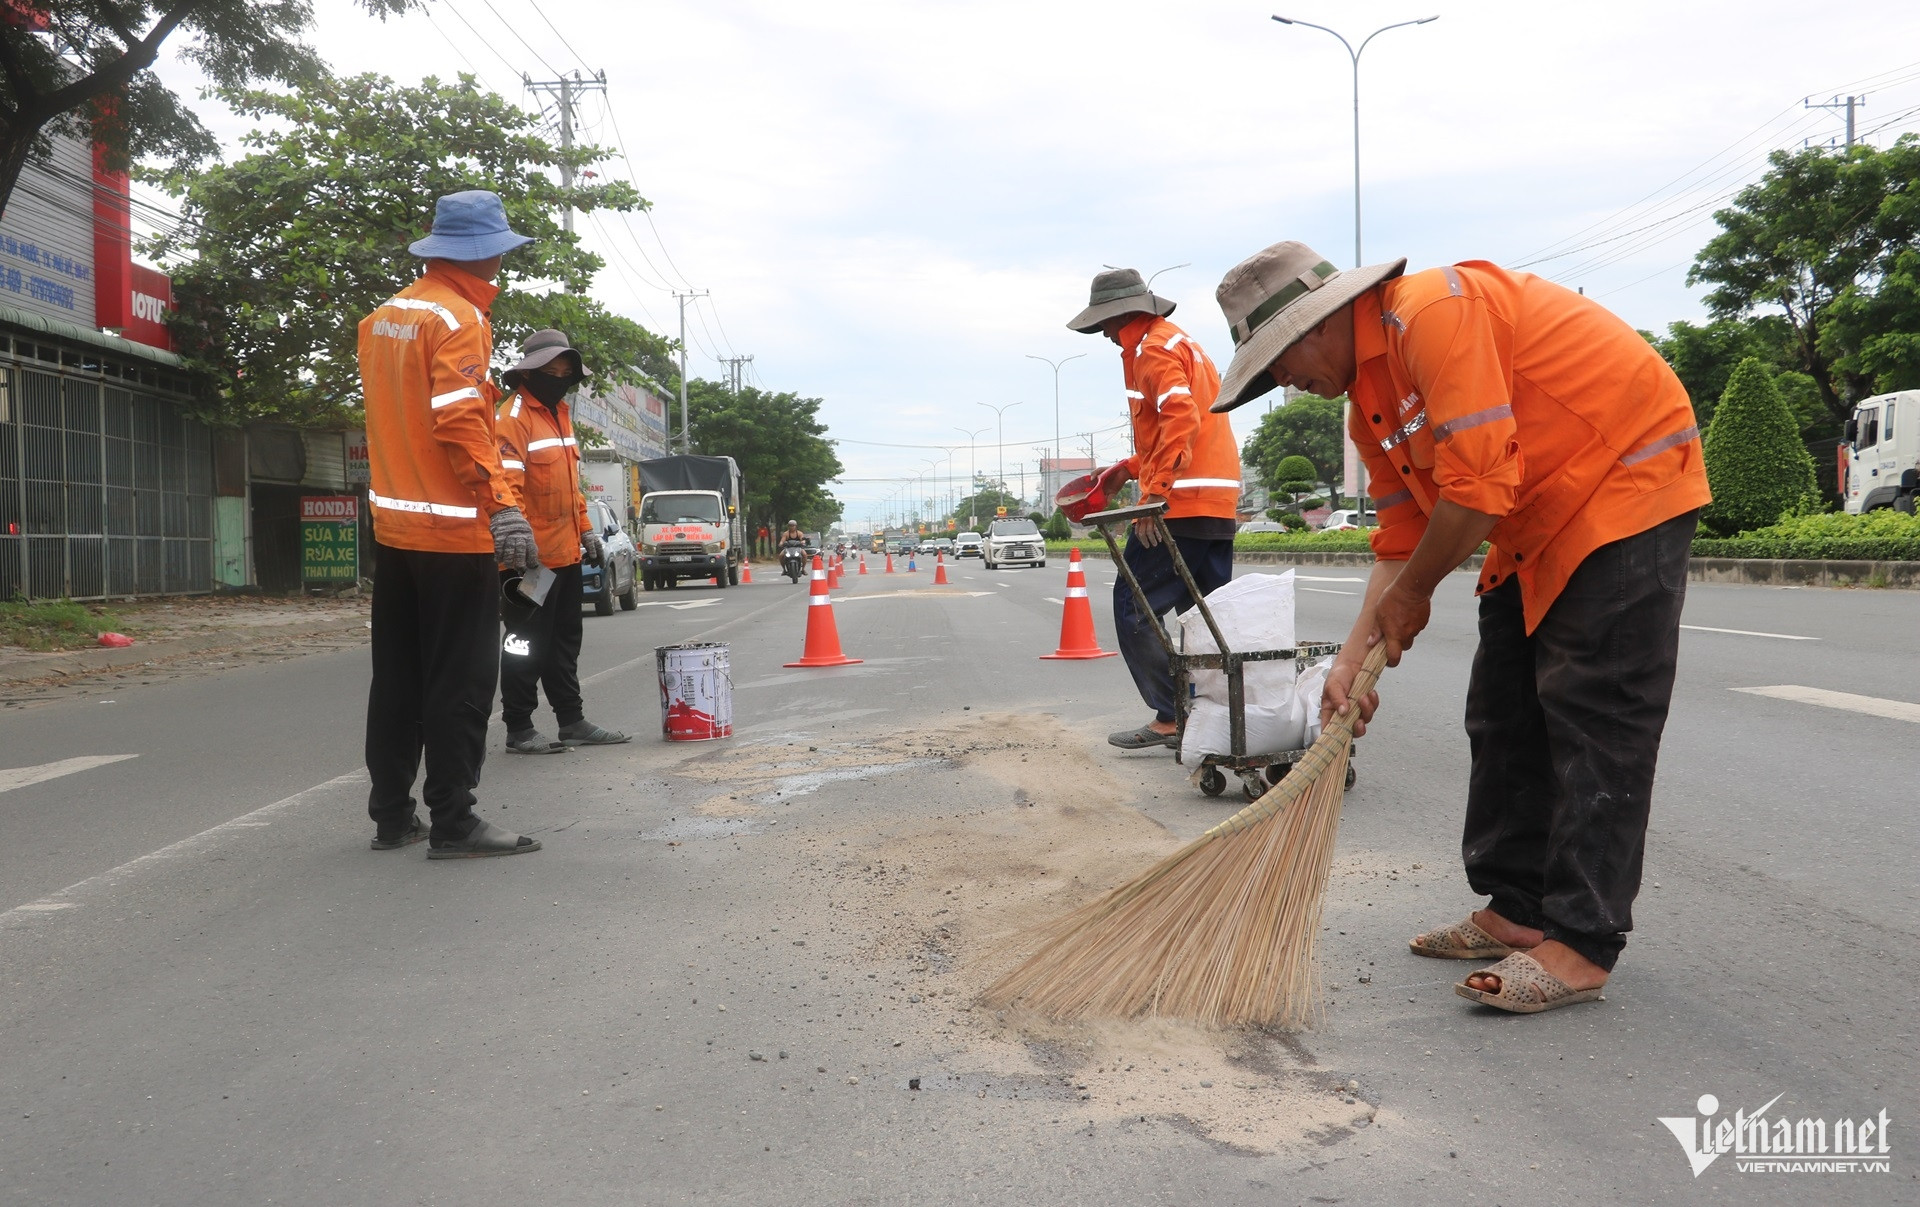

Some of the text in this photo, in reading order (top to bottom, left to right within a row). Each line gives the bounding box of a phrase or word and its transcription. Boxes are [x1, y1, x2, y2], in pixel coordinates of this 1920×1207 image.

[303, 501, 355, 516] HONDA
[305, 524, 355, 542] SỬA XE
[305, 544, 355, 561] RỬA XE
[305, 564, 355, 578] THAY NHỚT
